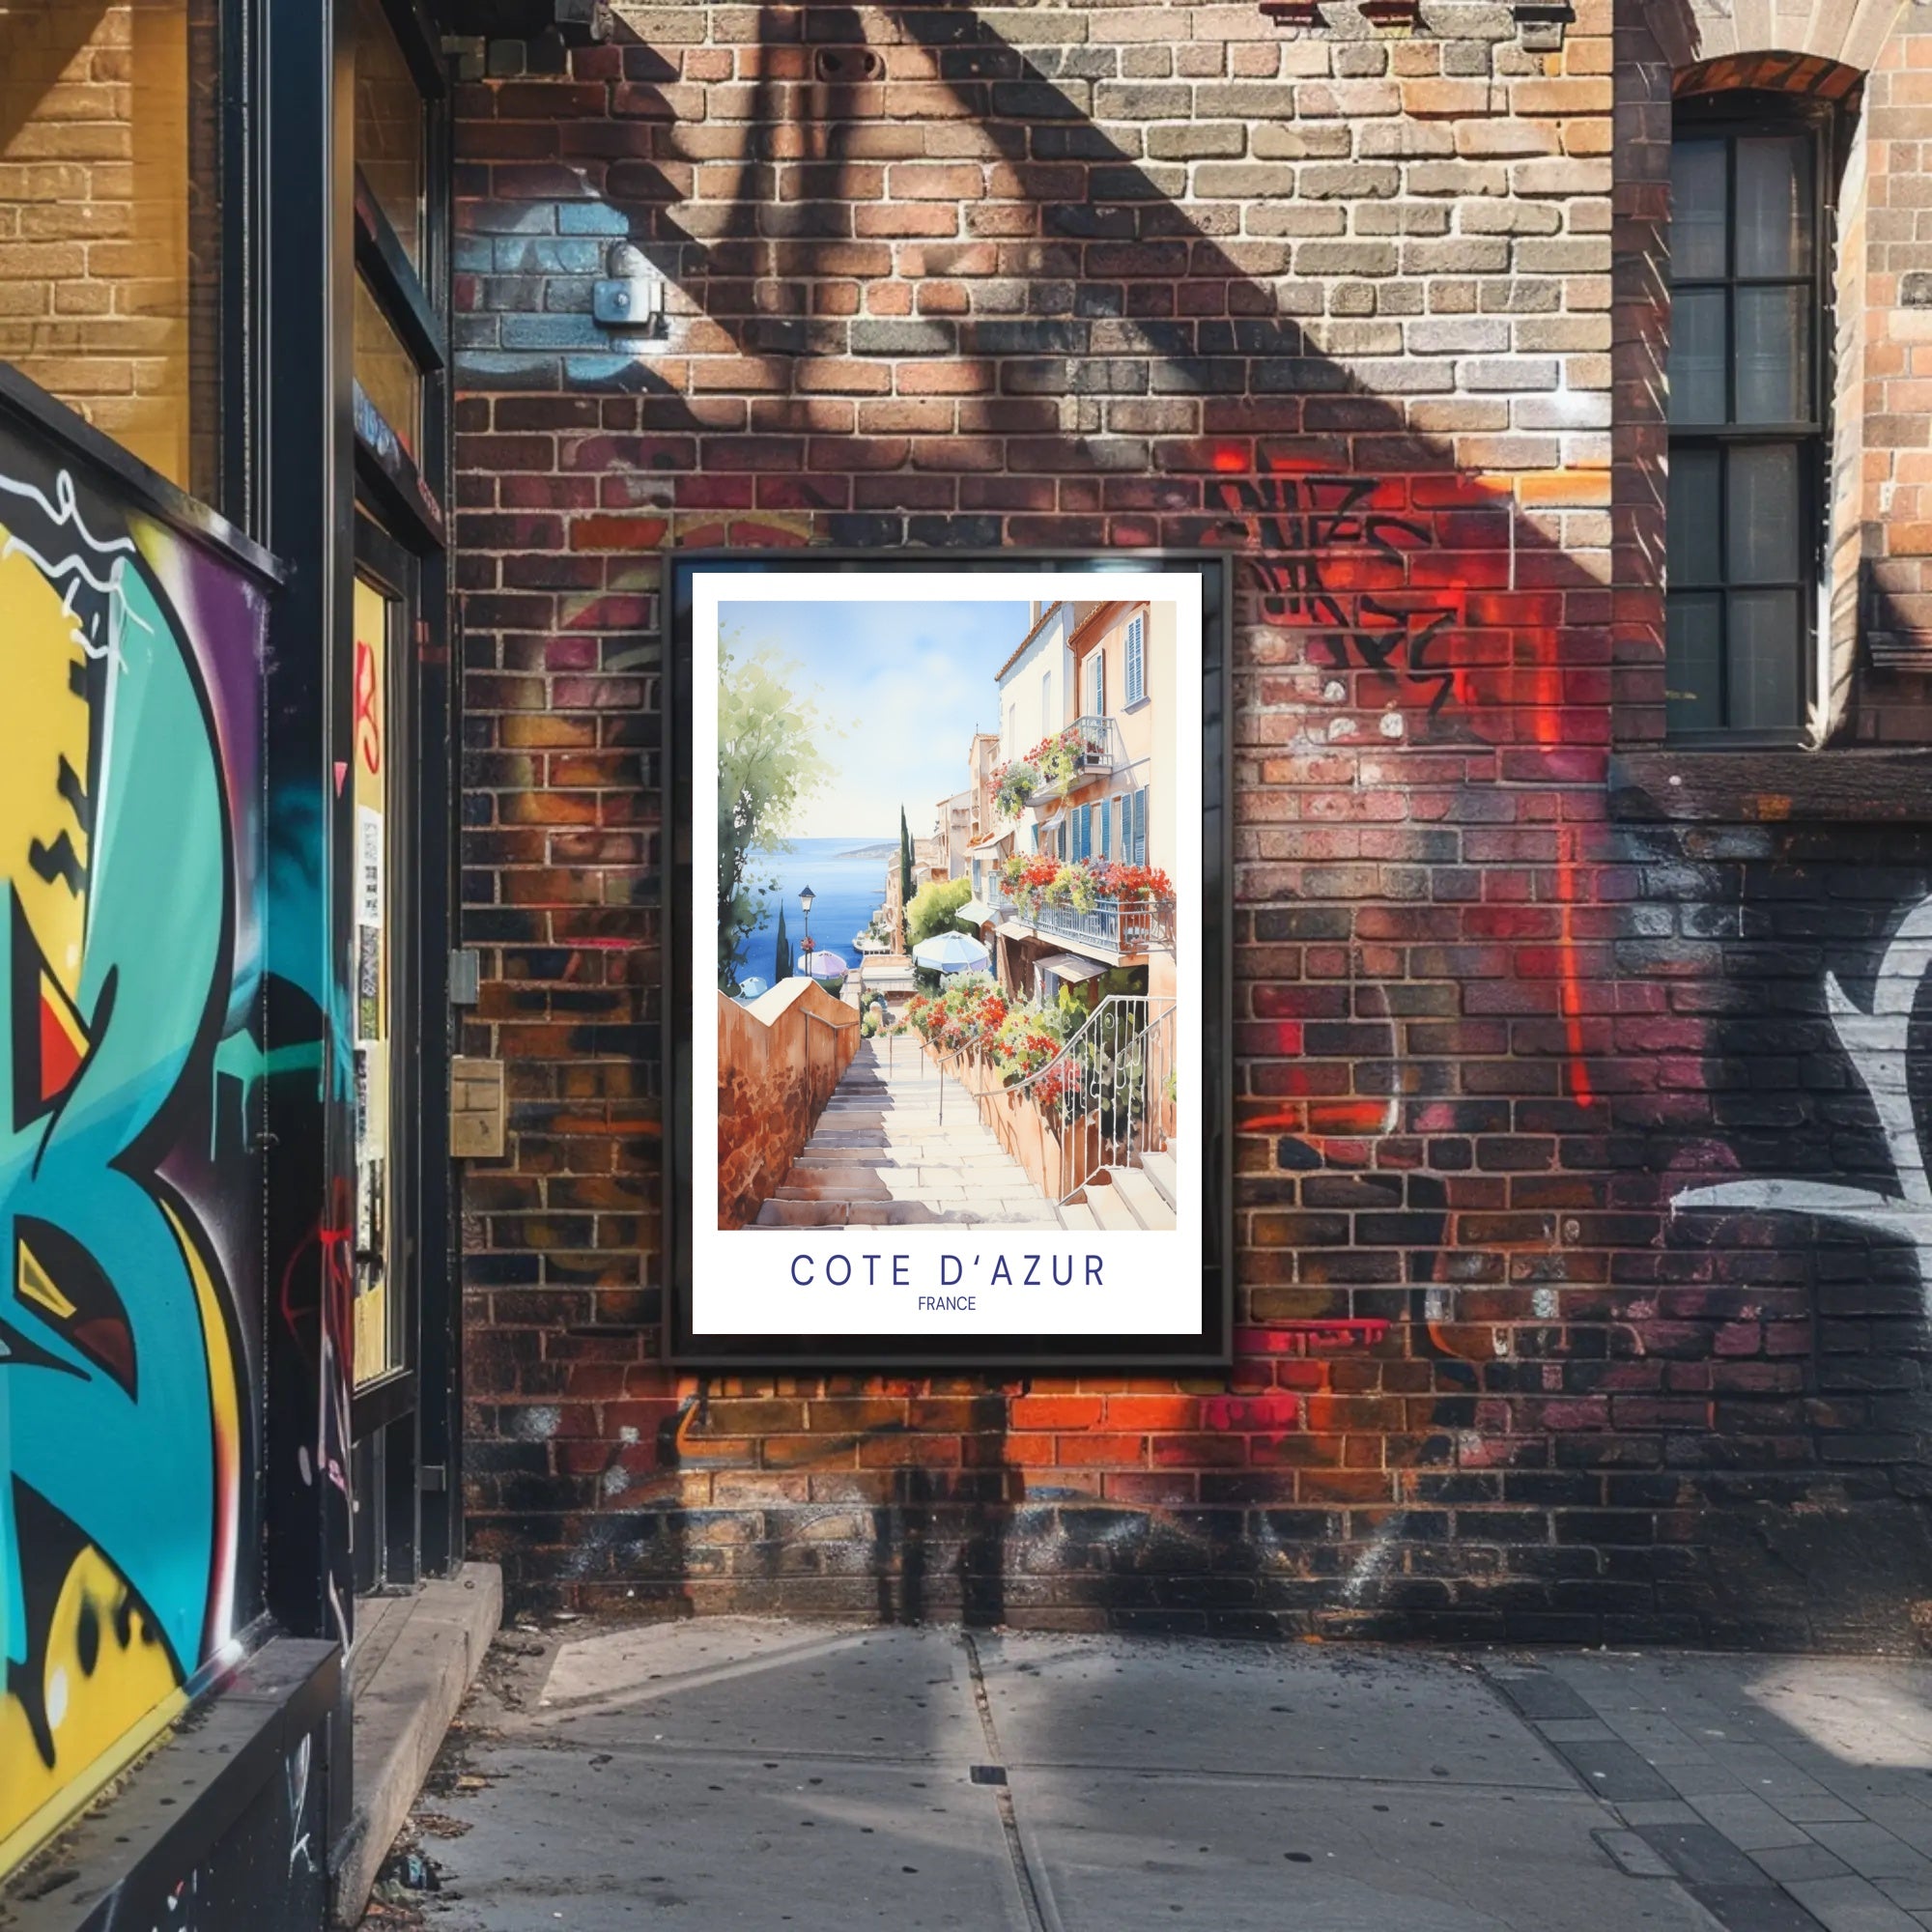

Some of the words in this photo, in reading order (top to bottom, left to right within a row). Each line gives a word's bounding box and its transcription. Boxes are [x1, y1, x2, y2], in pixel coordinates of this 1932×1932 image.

[791, 1254, 910, 1286] COTE
[941, 1254, 1103, 1286] D'AZUR
[918, 1295, 977, 1311] FRANCE
